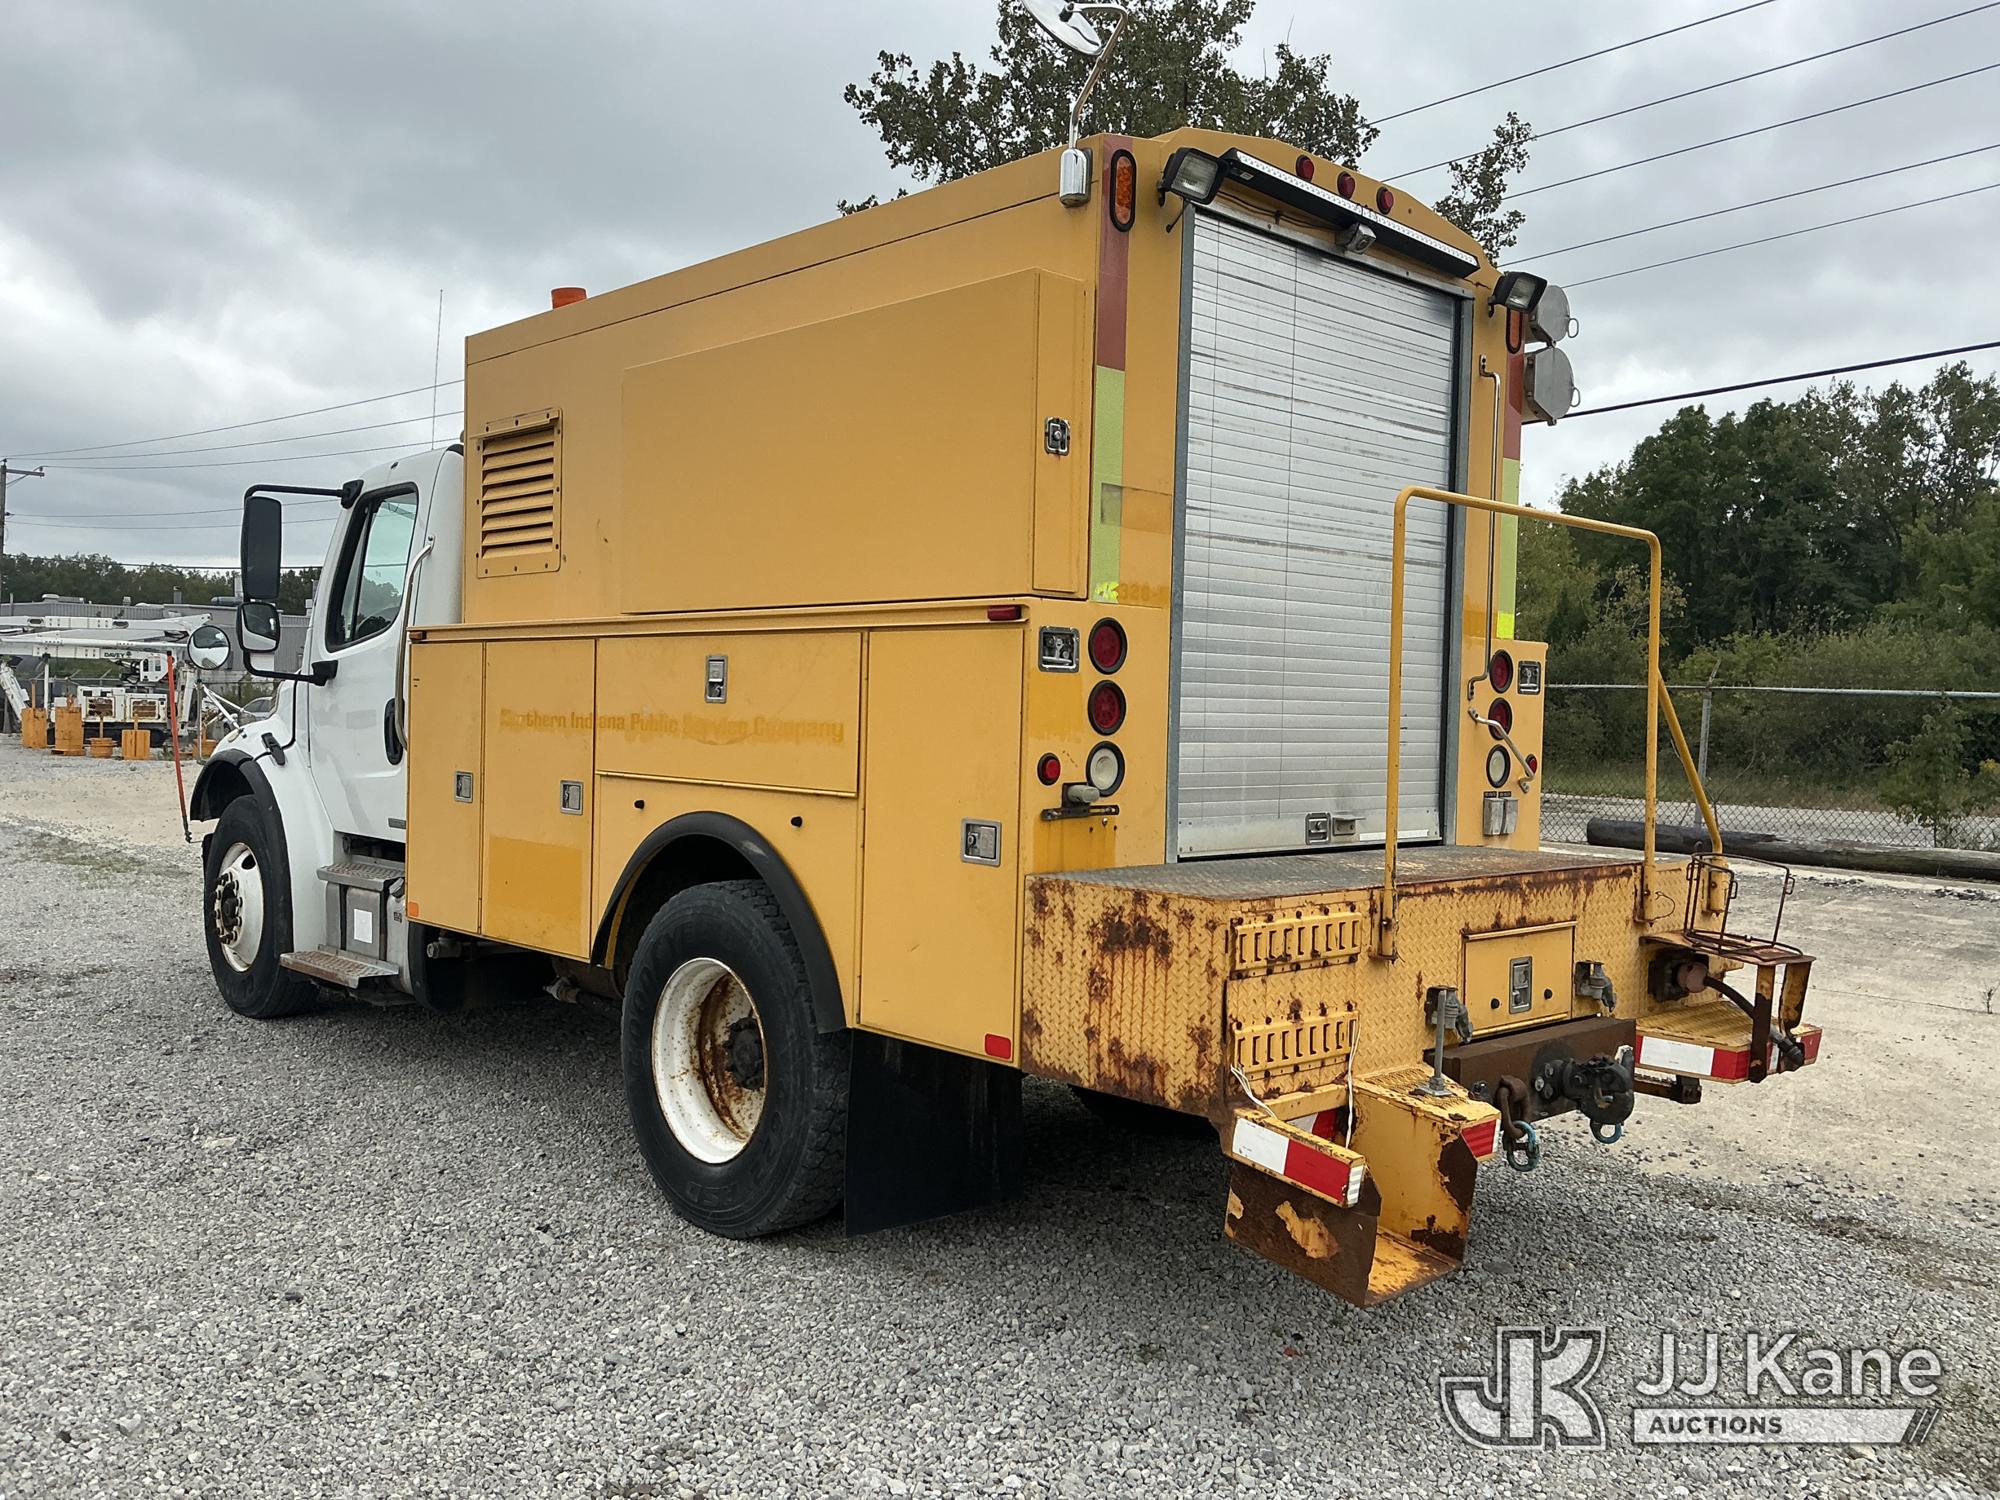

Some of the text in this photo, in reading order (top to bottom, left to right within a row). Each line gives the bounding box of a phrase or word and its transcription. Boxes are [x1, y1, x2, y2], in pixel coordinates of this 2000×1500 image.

[571, 711, 625, 730] Indiana
[630, 712, 678, 734] Public
[753, 716, 845, 743] Company
